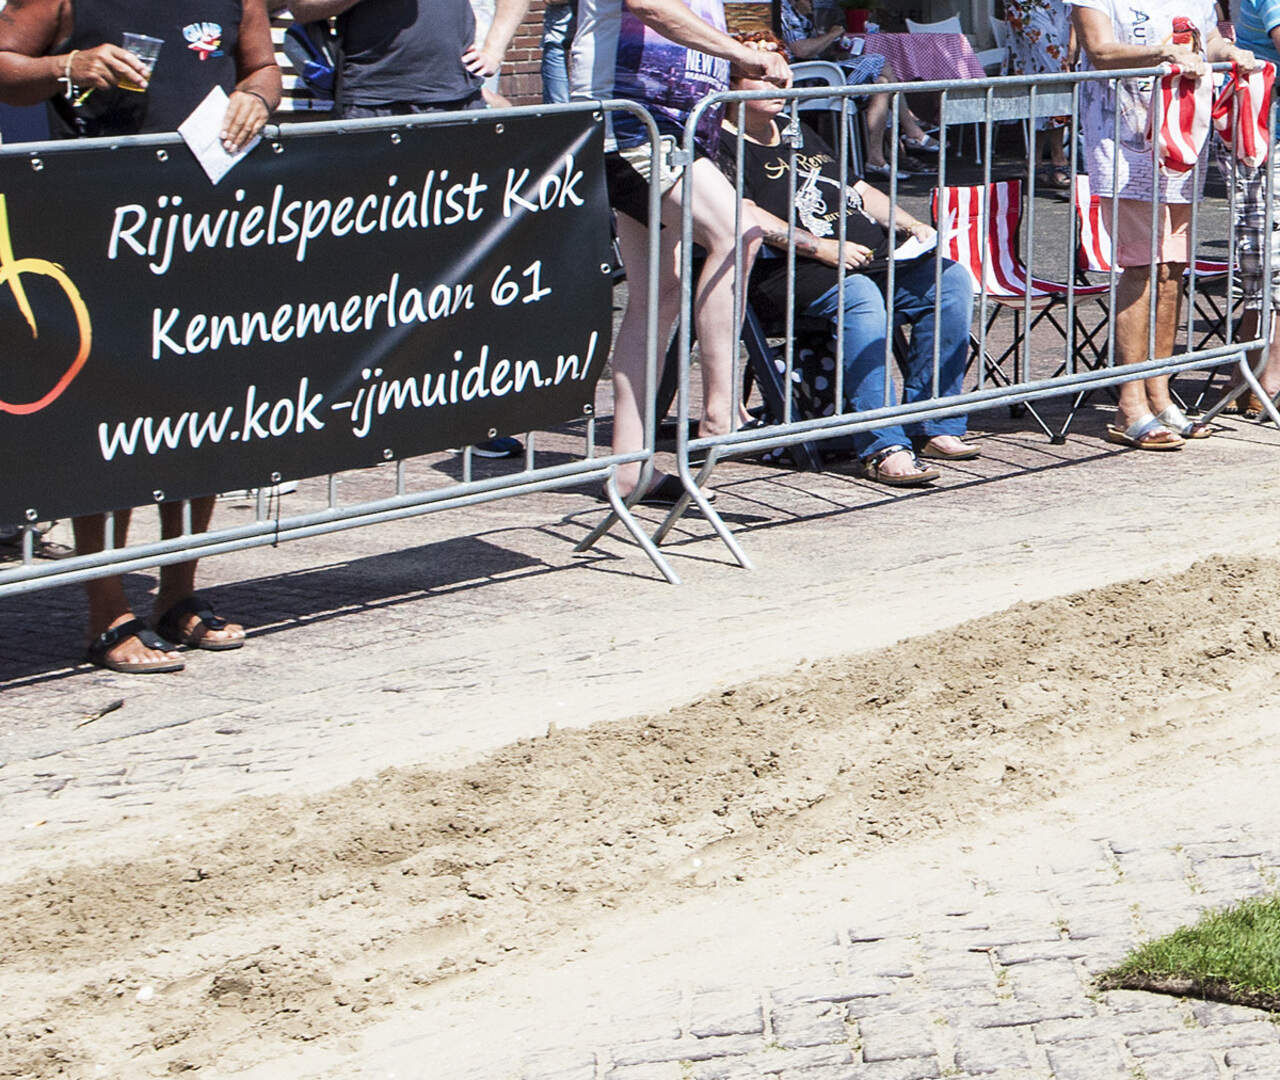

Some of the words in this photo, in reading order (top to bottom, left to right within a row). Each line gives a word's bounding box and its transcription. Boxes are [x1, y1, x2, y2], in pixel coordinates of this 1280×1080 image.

[108, 168, 487, 275] Rijwielspecialist
[503, 154, 585, 218] Kok
[152, 272, 475, 360] Kennemerlaan
[490, 259, 552, 308] 61
[97, 331, 598, 461] www.kok-ijmuiden.nl
